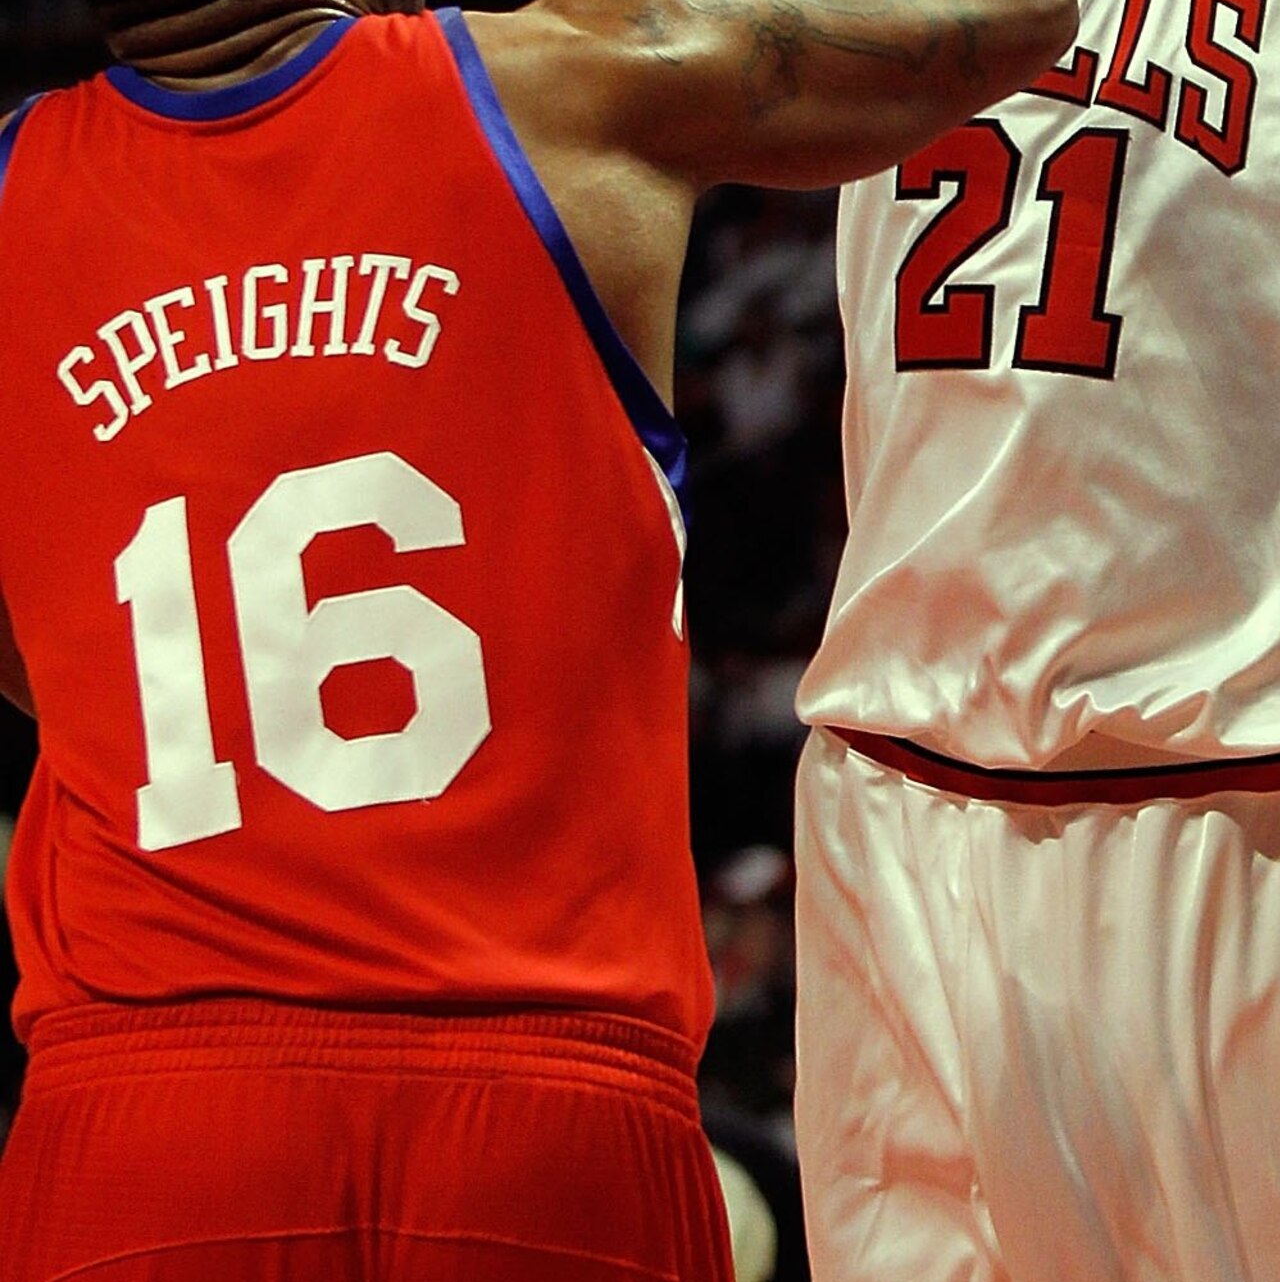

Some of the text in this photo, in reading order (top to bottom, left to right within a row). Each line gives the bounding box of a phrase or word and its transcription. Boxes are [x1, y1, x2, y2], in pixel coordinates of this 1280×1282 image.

[56, 252, 461, 442] SPEIGHTS
[895, 117, 1130, 379] 21
[113, 450, 494, 853] 16
